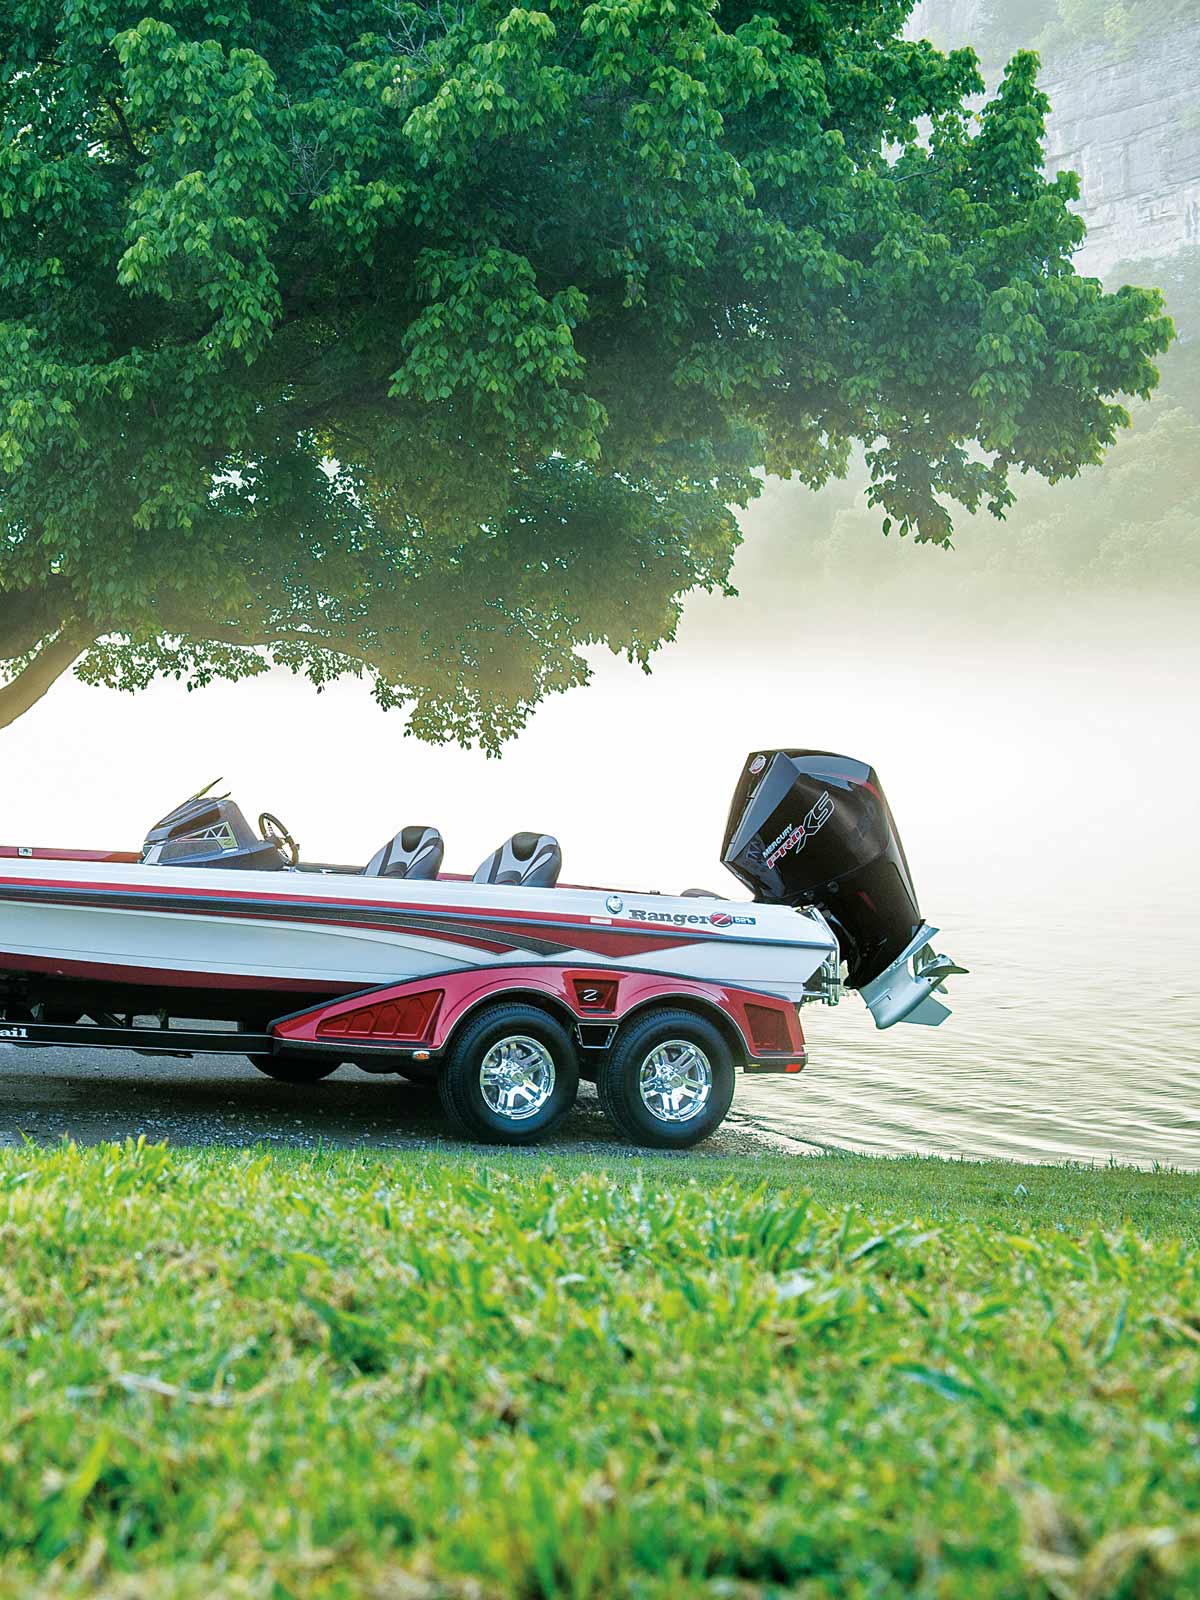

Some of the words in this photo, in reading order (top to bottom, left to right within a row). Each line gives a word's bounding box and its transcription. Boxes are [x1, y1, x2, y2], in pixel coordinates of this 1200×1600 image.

[762, 823, 793, 858] MERCURY
[767, 825, 805, 869] PRO
[796, 790, 835, 854] XS
[628, 909, 711, 926] Ranger
